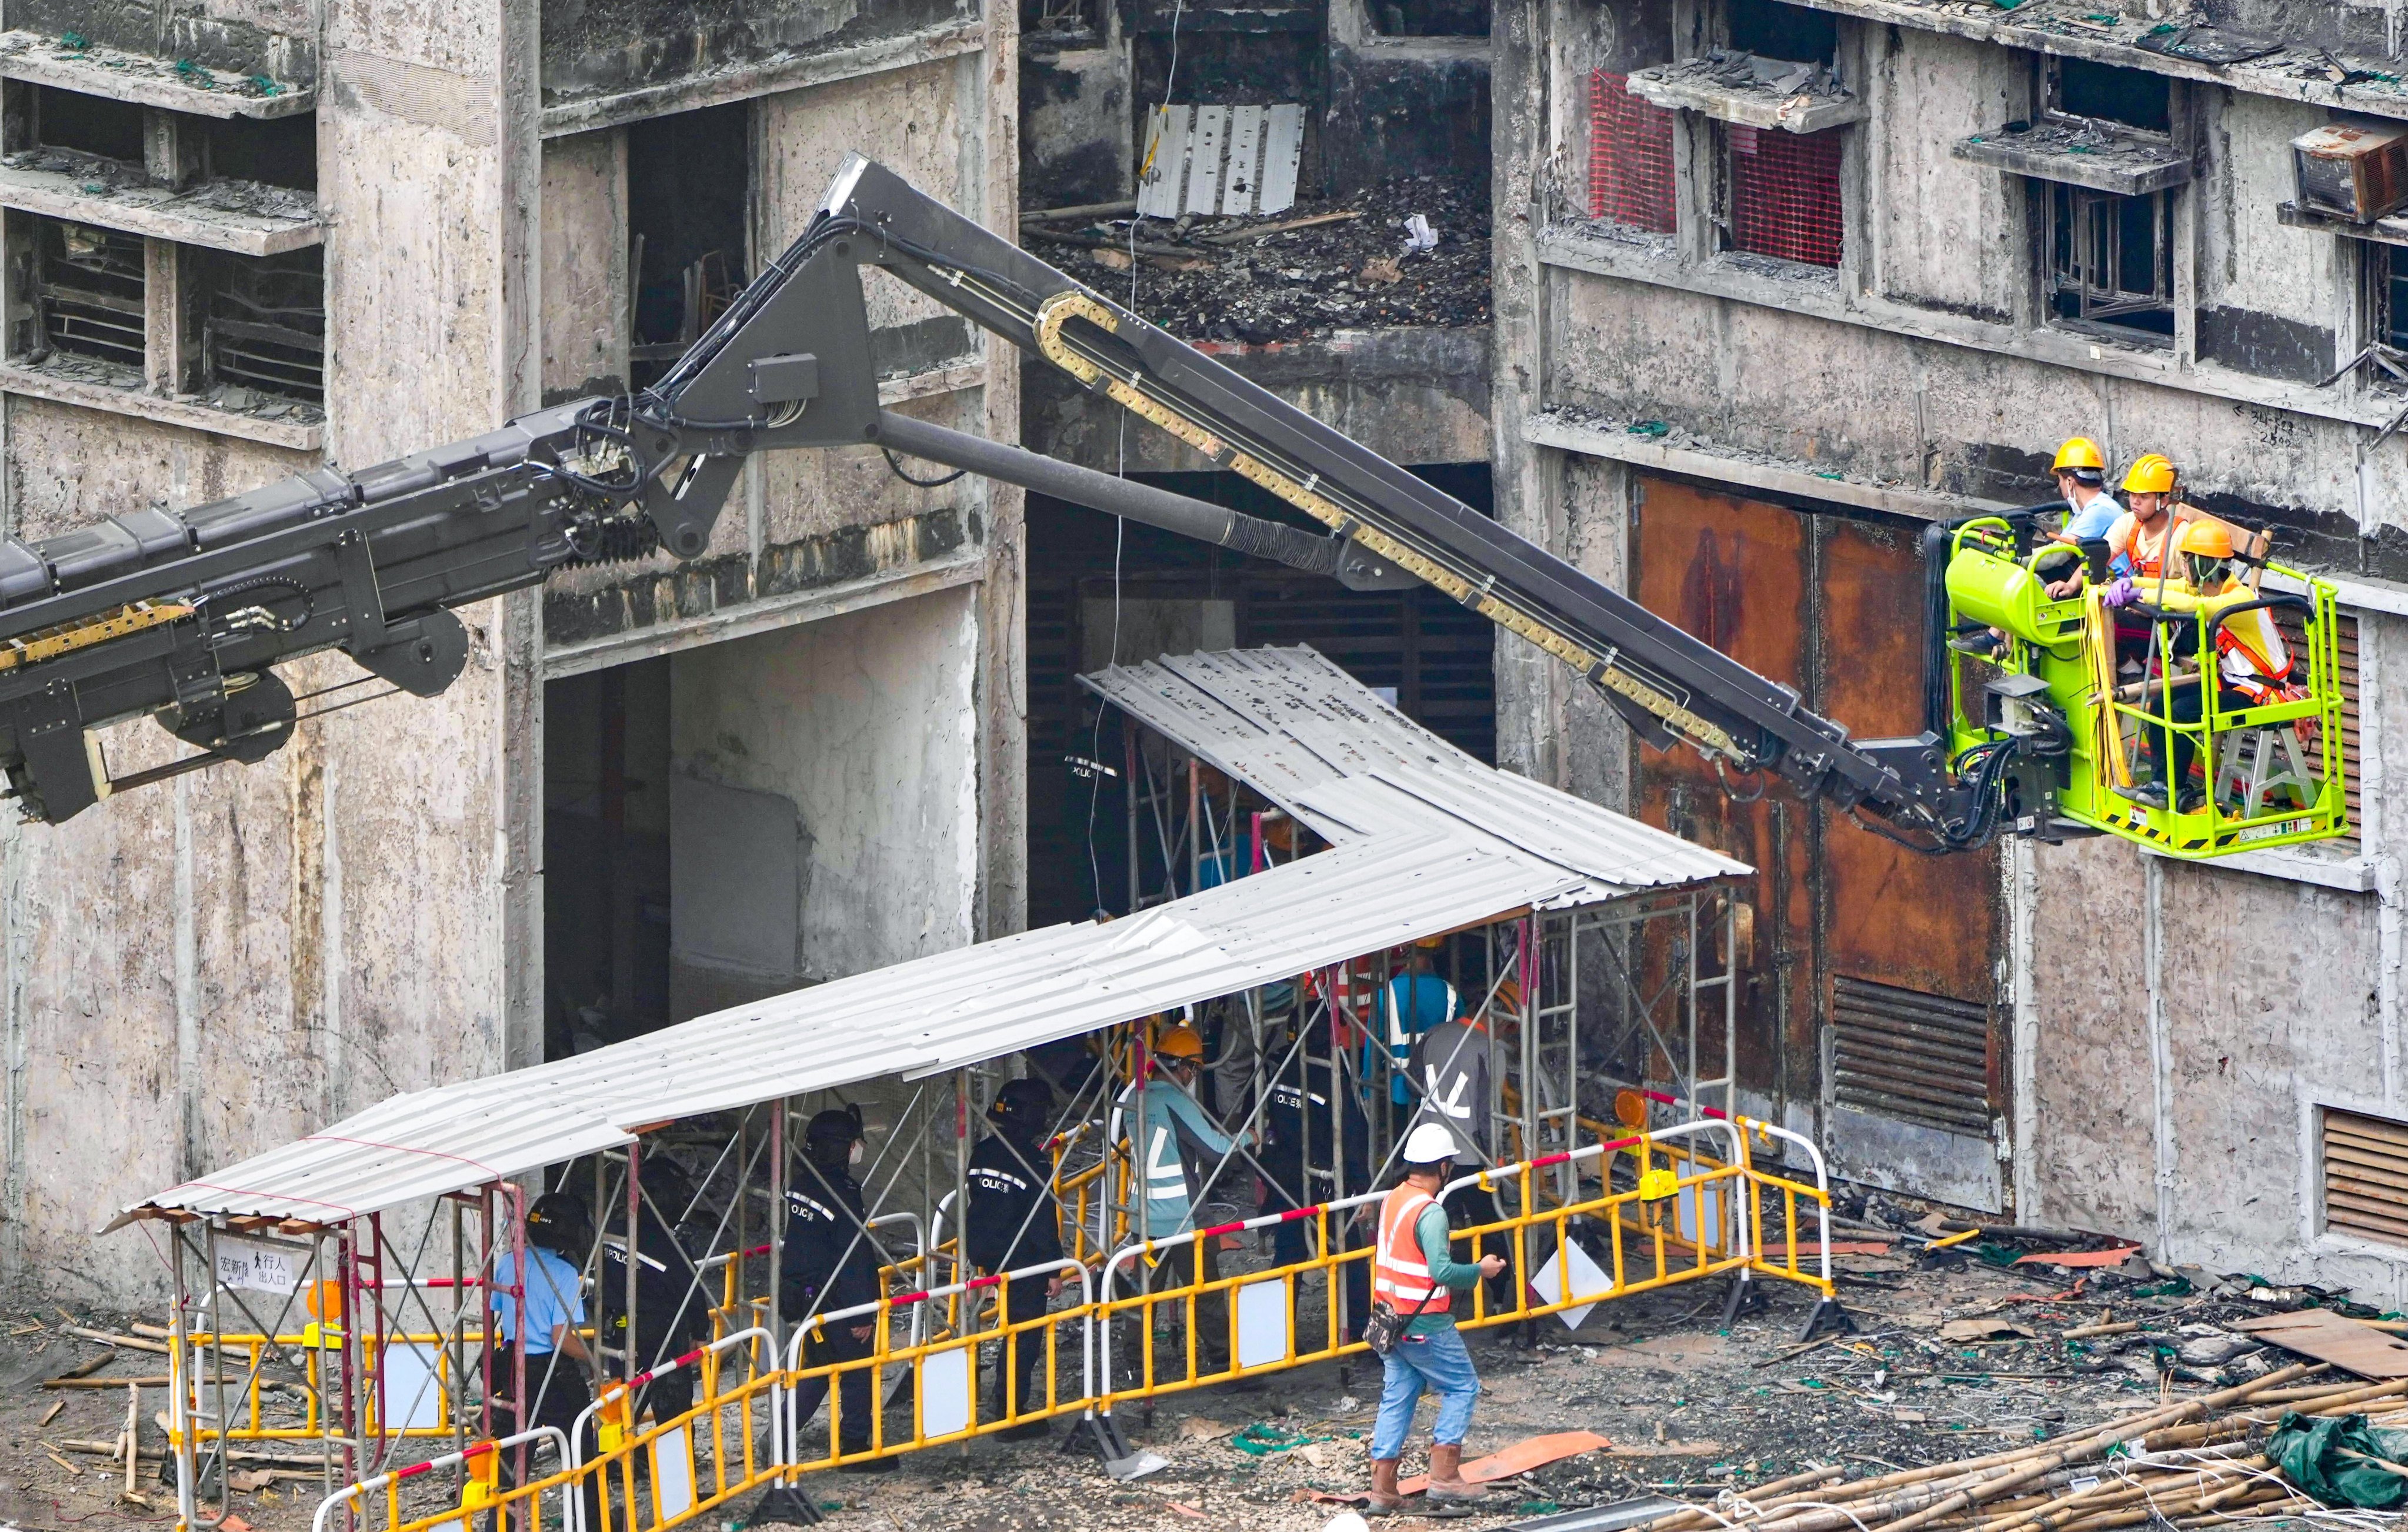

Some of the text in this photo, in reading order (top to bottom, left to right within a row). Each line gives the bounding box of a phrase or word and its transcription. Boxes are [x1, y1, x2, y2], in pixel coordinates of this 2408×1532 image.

[979, 1178, 1003, 1191] OLIC
[264, 1254, 285, 1271] 行人
[608, 1249, 628, 1264] POLIC
